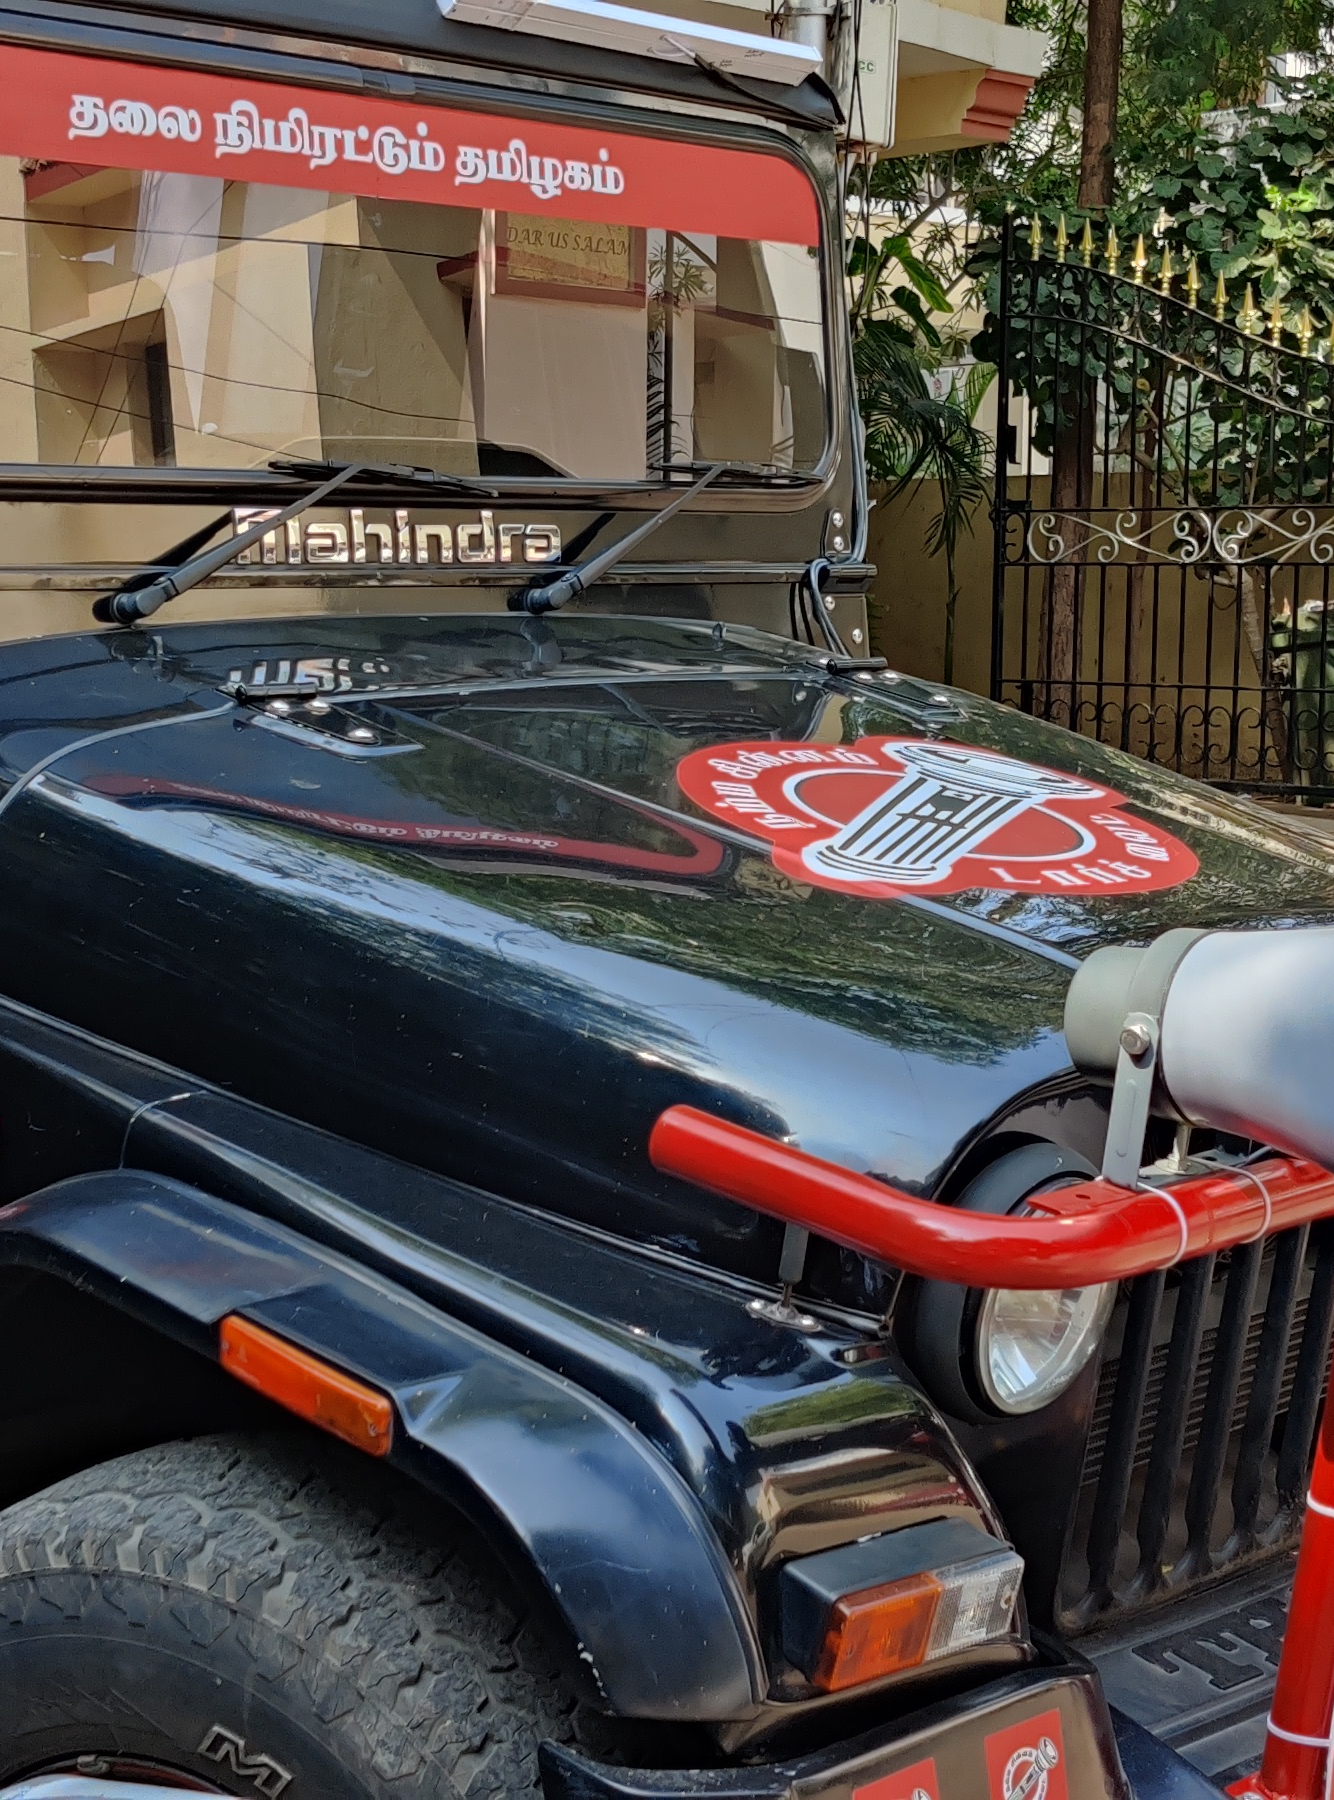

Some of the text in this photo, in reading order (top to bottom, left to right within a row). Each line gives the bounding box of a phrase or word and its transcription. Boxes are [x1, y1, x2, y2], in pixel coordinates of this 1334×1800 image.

[69, 93, 626, 200] தலை நிமிரட்டும் தமிழகம்
[507, 225, 544, 246] DAR
[548, 230, 569, 249] US
[233, 507, 562, 564] Mahindra
[708, 748, 879, 779] சின்னம்
[711, 781, 817, 829] நம்ம
[989, 813, 1170, 886] டார்ச் லைட்
